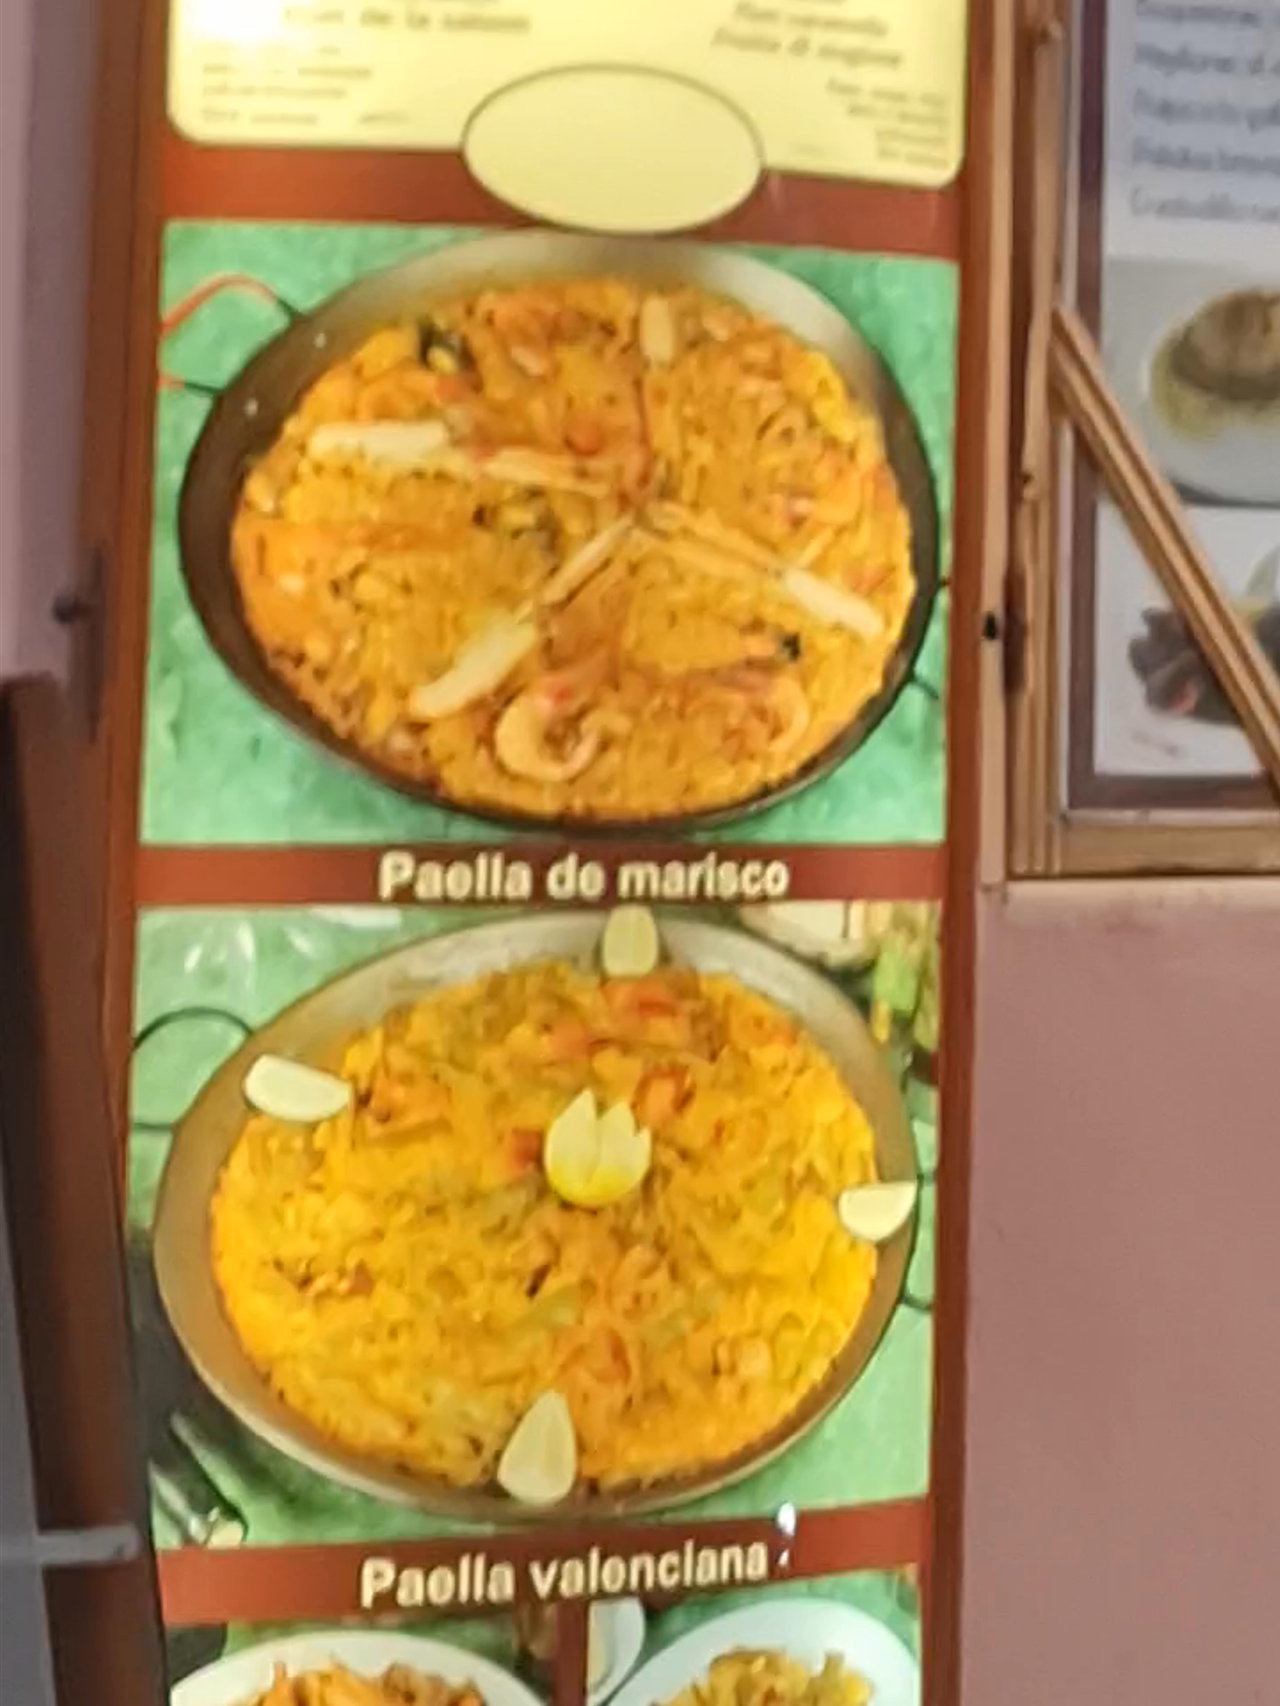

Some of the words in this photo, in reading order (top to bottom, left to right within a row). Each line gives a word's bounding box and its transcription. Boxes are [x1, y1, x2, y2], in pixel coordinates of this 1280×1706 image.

[378, 848, 533, 903] Paella
[545, 850, 606, 900] de
[615, 849, 791, 900] marisco
[358, 1552, 518, 1610] Paella
[527, 1536, 769, 1600] valenciana
